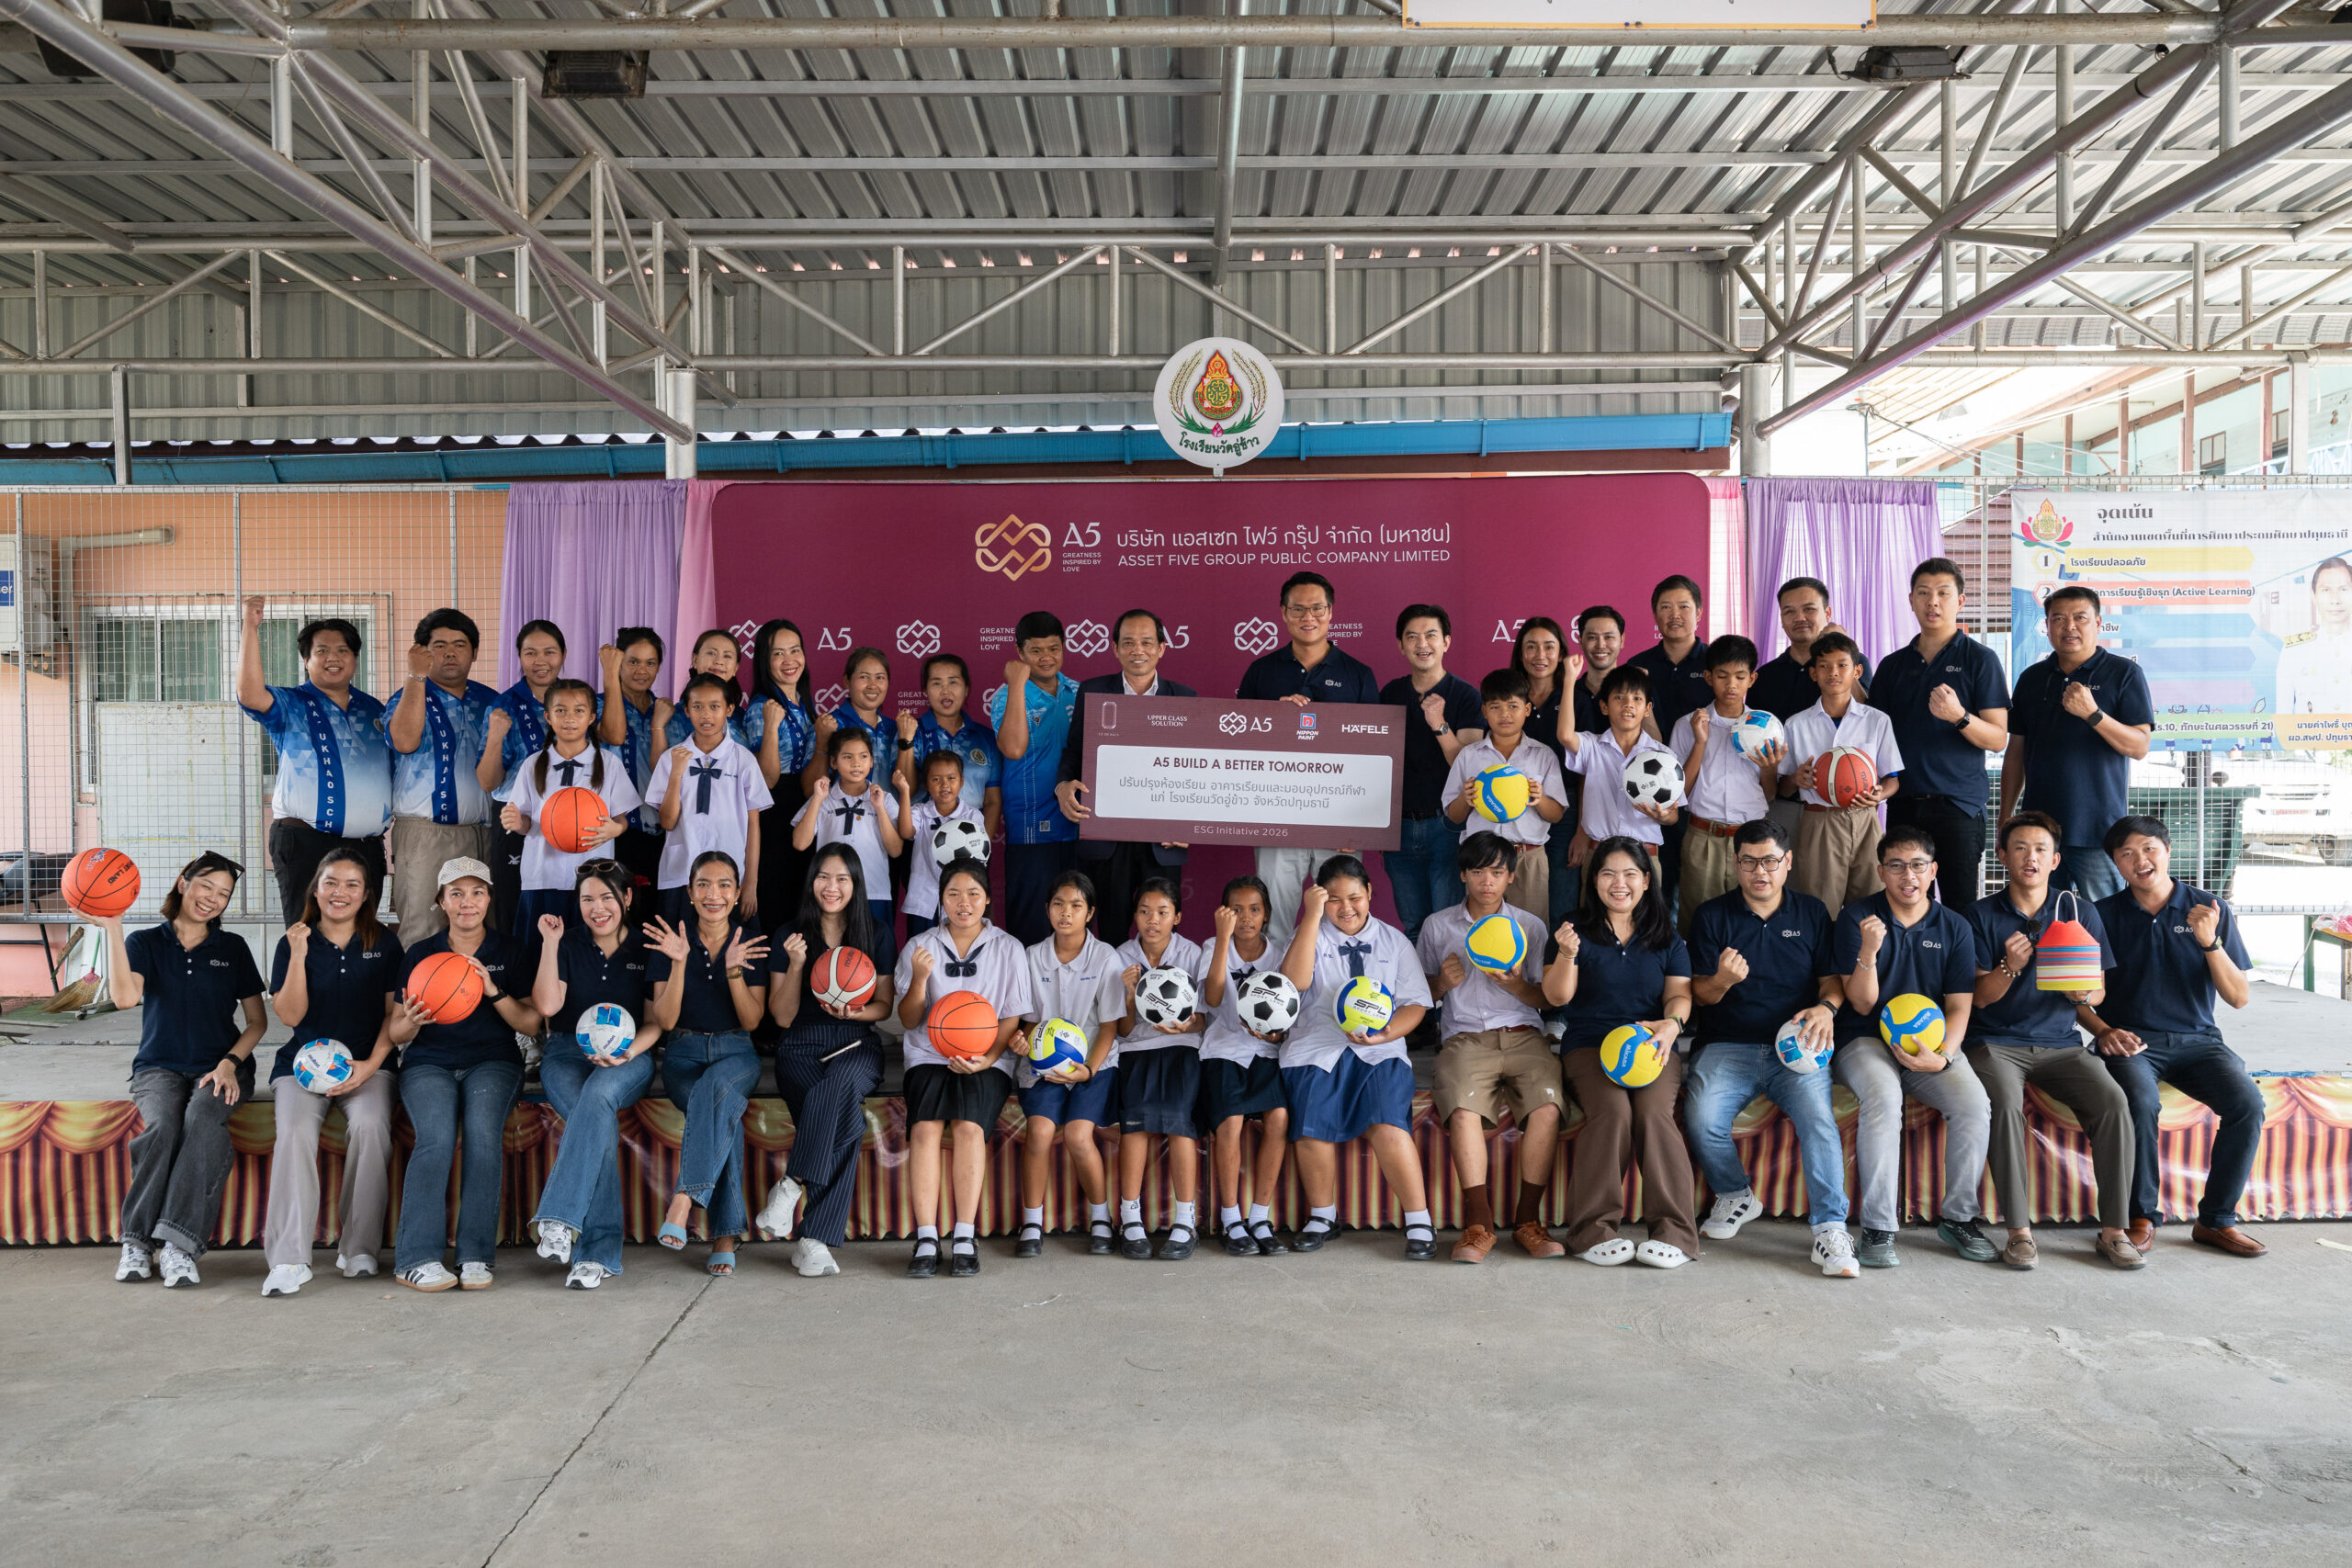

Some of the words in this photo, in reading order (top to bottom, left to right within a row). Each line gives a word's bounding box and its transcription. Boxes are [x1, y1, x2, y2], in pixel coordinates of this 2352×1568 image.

[1179, 432, 1260, 457] โรงเรียนวัดอู่ข้าว
[2097, 503, 2154, 524] จุดเน้น
[1062, 522, 1102, 547] A5
[1116, 529, 1165, 547] บริษัท
[1172, 529, 1238, 547] แอสเซท
[1243, 525, 1278, 546] ไฟว์
[1283, 525, 1319, 550] กรุ๊ป
[1325, 525, 1373, 545] จำกัด
[1380, 522, 1451, 545] (มหาชน)
[1118, 554, 1164, 567] ASSET
[1169, 554, 1200, 566] FIVE
[1204, 553, 1256, 565] GROUP
[1261, 553, 1312, 564] PUBLIC
[1317, 551, 1390, 563] COMPANY
[1395, 550, 1451, 561] LIMITED
[2070, 557, 2146, 567] โรงเรียนปลอดภัย
[2172, 587, 2206, 597] (Active
[2209, 586, 2256, 597] Learning)
[817, 627, 853, 651] A5
[1250, 716, 1272, 733] A5
[1341, 724, 1389, 735] HÄFELE
[2261, 721, 2274, 731] 21)
[1153, 757, 1170, 768] A5
[1173, 758, 1208, 769] BUILD
[1211, 759, 1221, 769] A
[1225, 760, 1265, 771] BETTER
[1269, 761, 1344, 774] TOMORROW
[1119, 776, 1206, 790] ปรับปรุงห้องเรียน
[1210, 780, 1366, 797] อาคารเรียนและมอบอุปกรณ์กีฬา
[1150, 791, 1165, 802] แก่
[1170, 791, 1250, 807] โรงเรียนวัดอู่ข้าว
[1253, 795, 1330, 810] จังหวัดปทุมธานี
[1194, 826, 1214, 834] ESG
[1216, 827, 1260, 836] Initiative
[1262, 829, 1288, 837] 2026
[107, 869, 125, 884] LAND
[1146, 992, 1176, 1014] SPL
[1251, 987, 1284, 1003] SPL
[1354, 998, 1386, 1016] SPL
